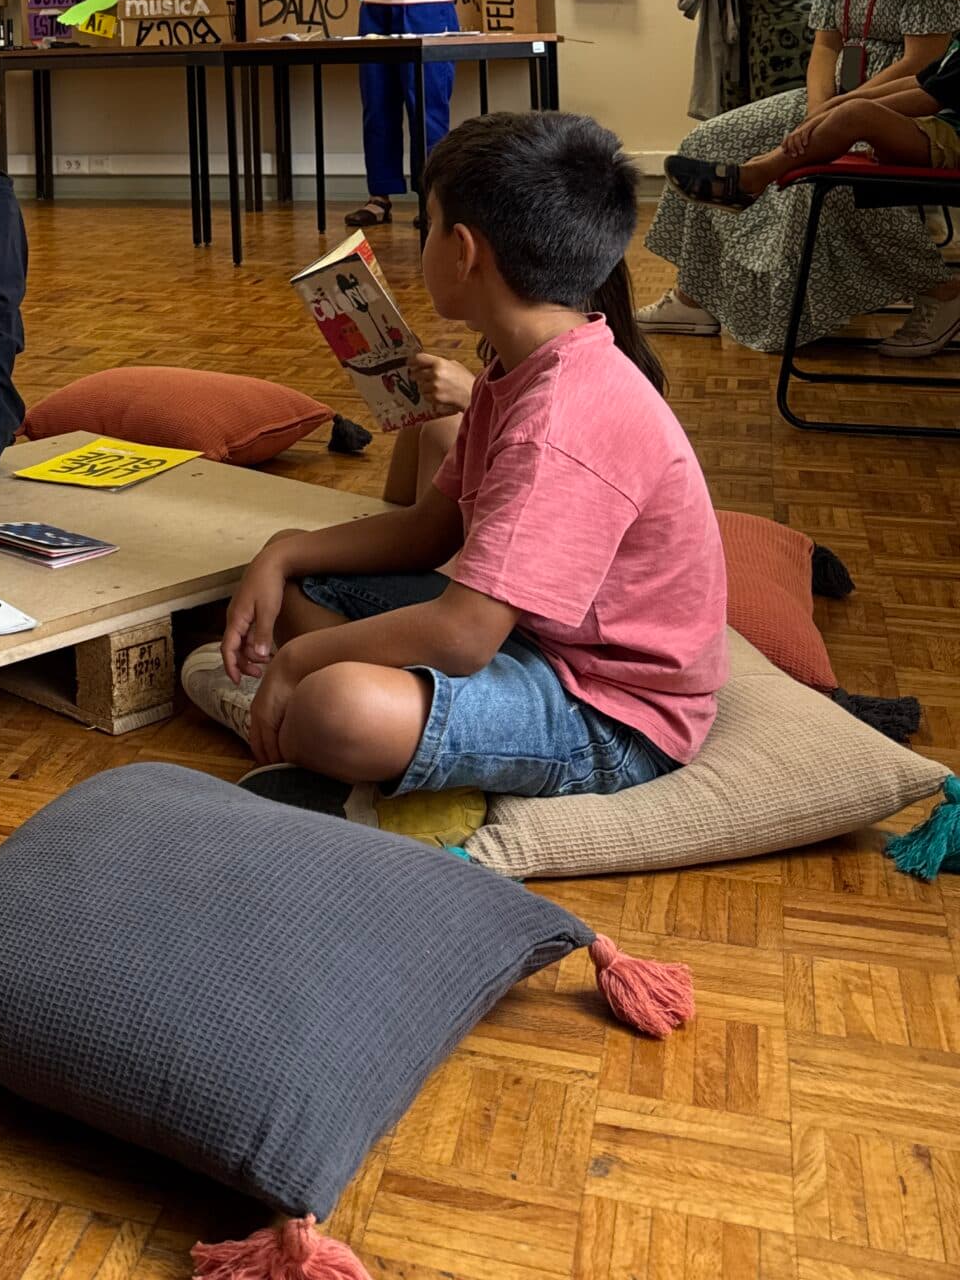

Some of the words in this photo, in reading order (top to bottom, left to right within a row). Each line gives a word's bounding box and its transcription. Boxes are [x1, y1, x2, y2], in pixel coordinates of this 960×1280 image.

[136, 17, 222, 47] BOCA
[48, 461, 139, 479] LIKE
[62, 451, 168, 470] GLUE
